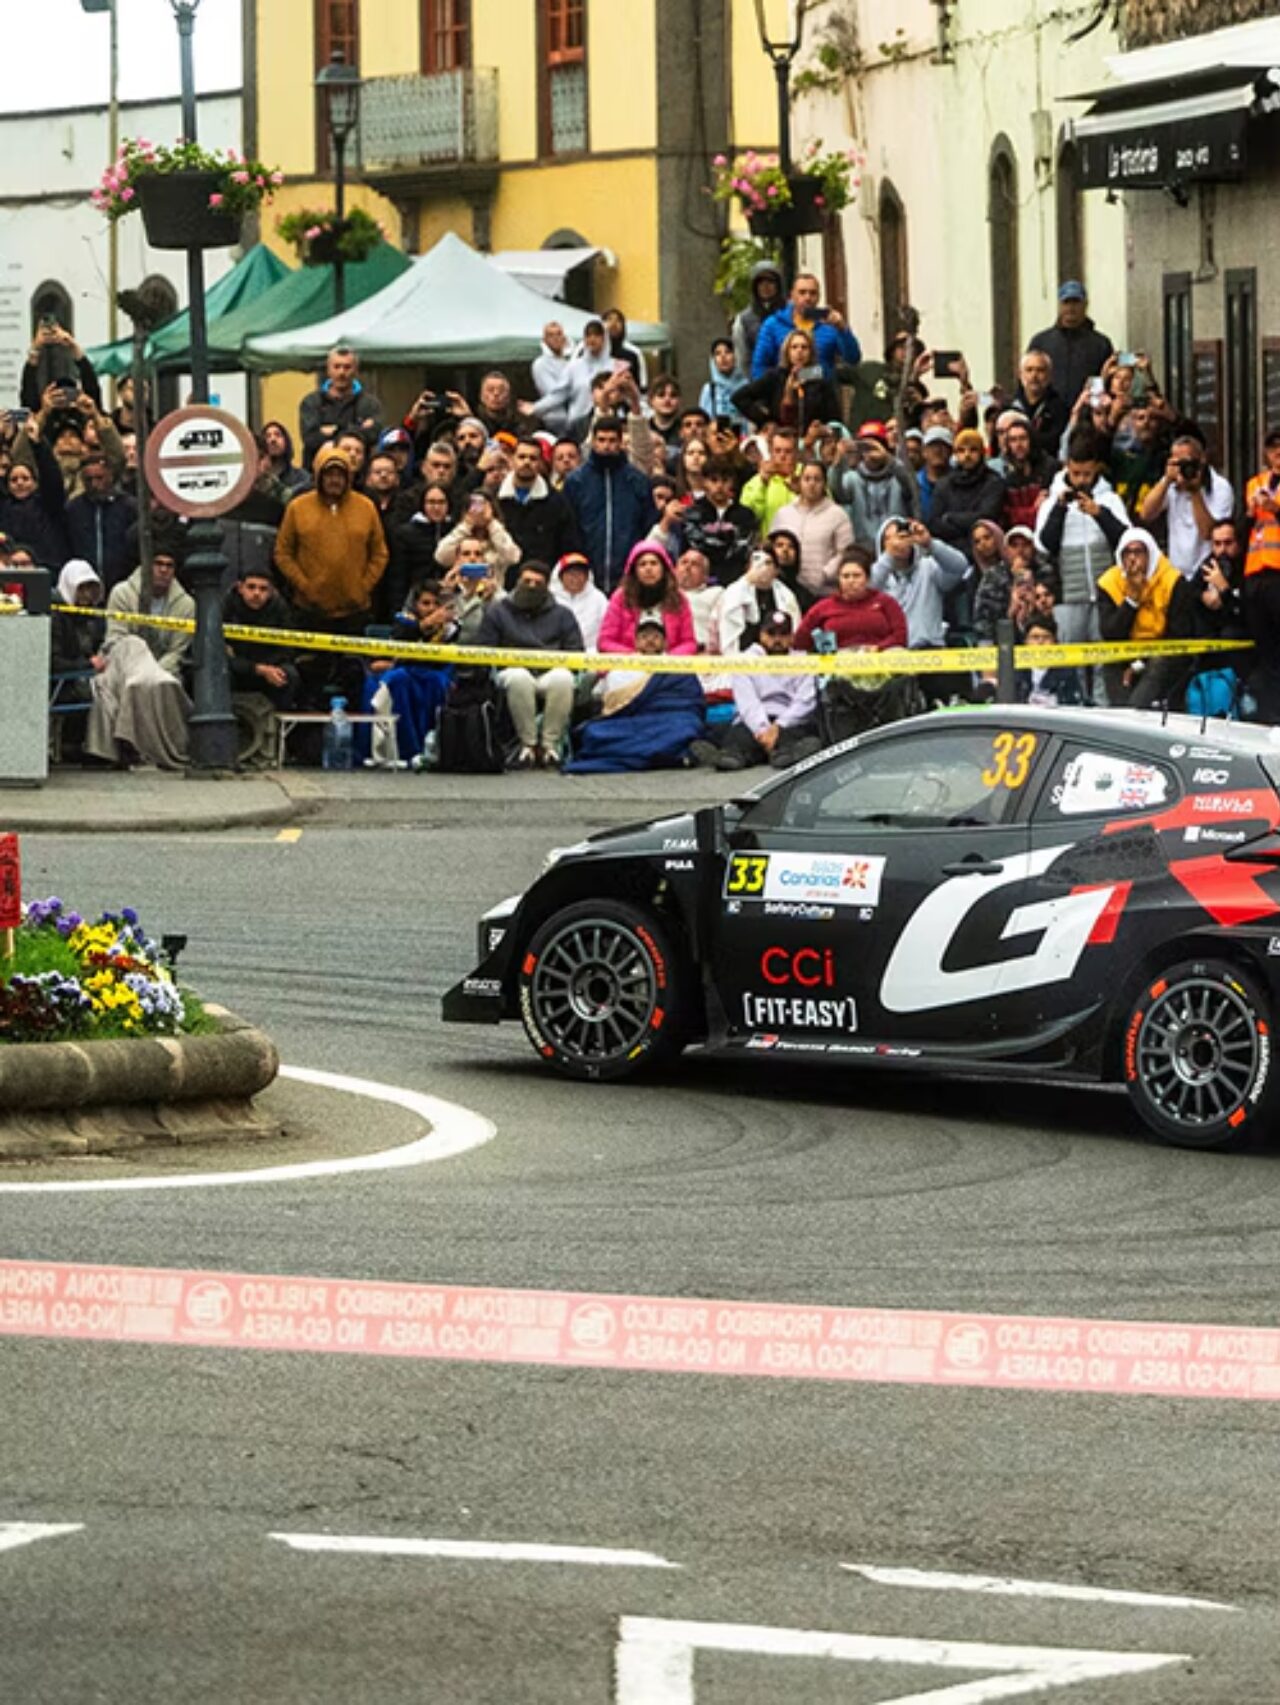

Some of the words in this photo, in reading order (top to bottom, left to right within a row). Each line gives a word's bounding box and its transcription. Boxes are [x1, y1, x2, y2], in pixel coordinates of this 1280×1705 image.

[979, 731, 1038, 790] 33
[728, 857, 768, 892] 33
[760, 945, 836, 988] CCi
